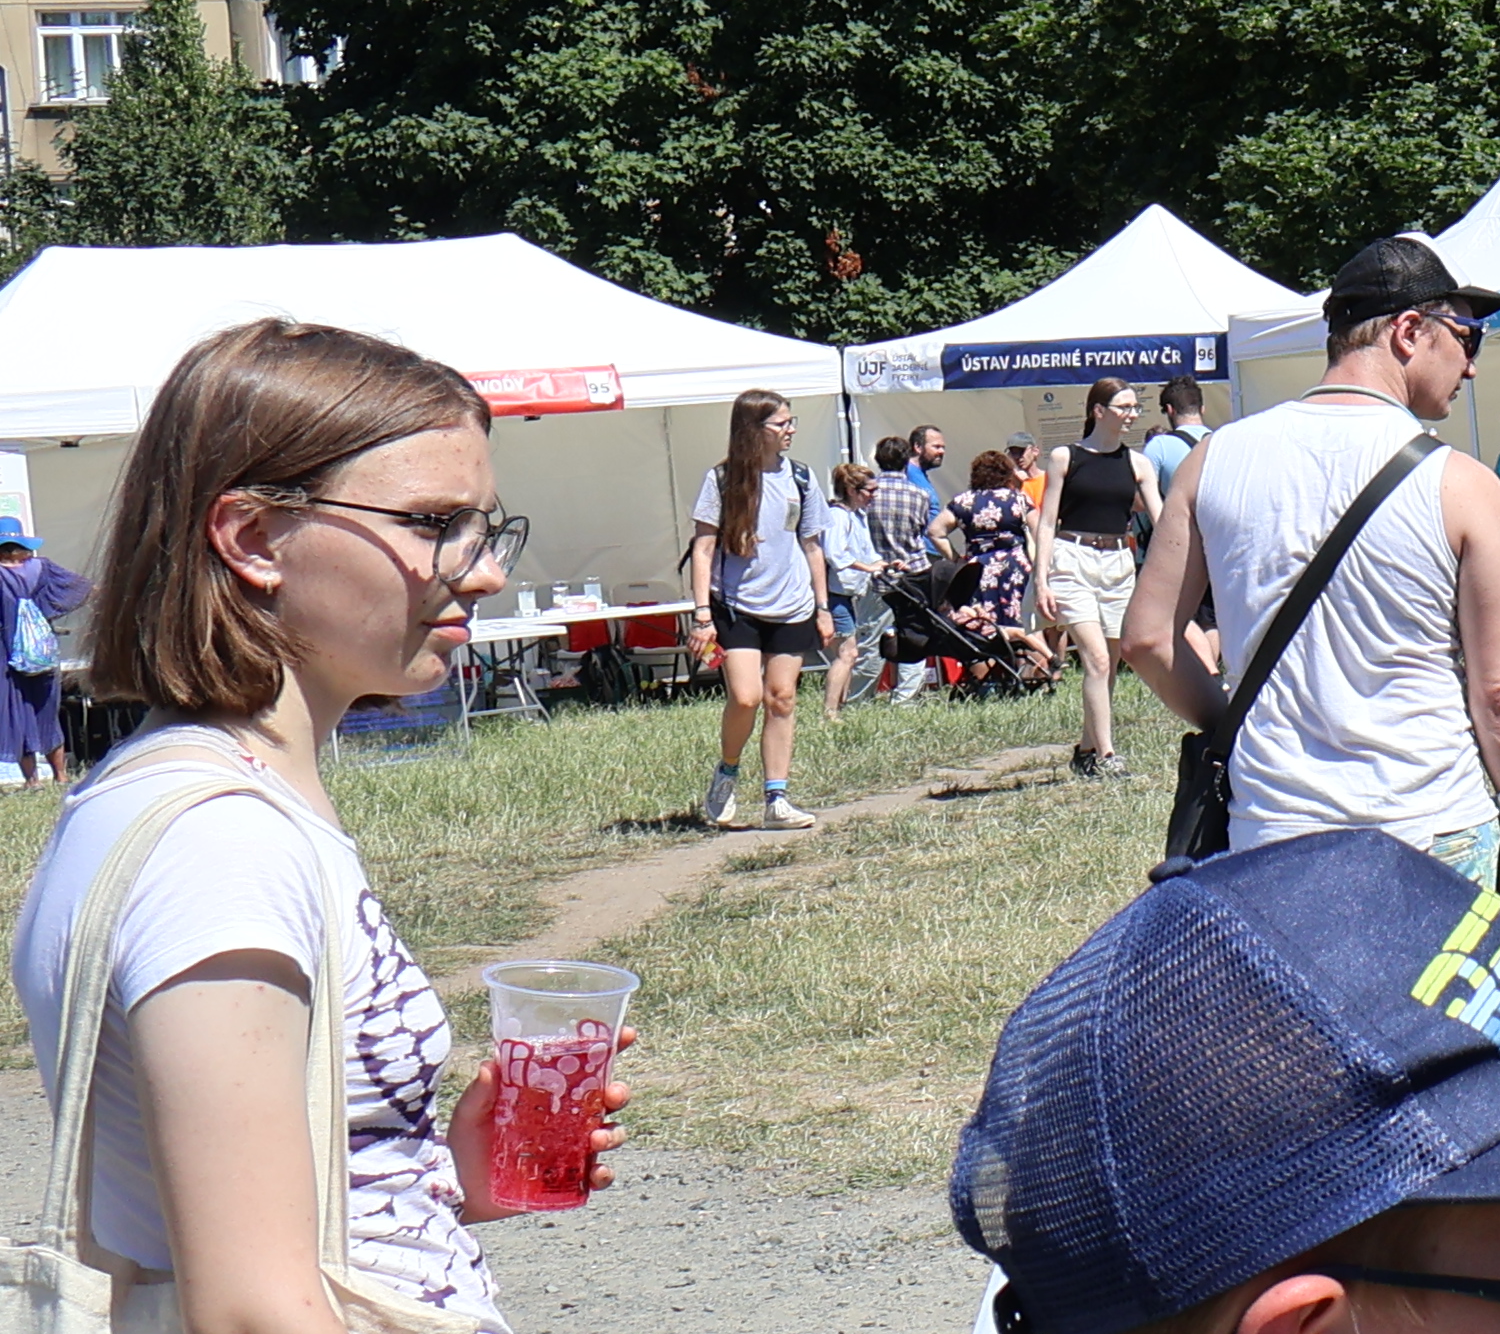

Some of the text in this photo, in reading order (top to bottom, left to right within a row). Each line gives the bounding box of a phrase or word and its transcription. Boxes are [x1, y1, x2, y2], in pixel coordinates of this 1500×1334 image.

[962, 343, 1183, 372] ÚSTAV JADERNÉ FYZIKY AV ČR
[1197, 348, 1215, 361] 96
[857, 357, 887, 375] ÚJF
[588, 383, 610, 395] 95
